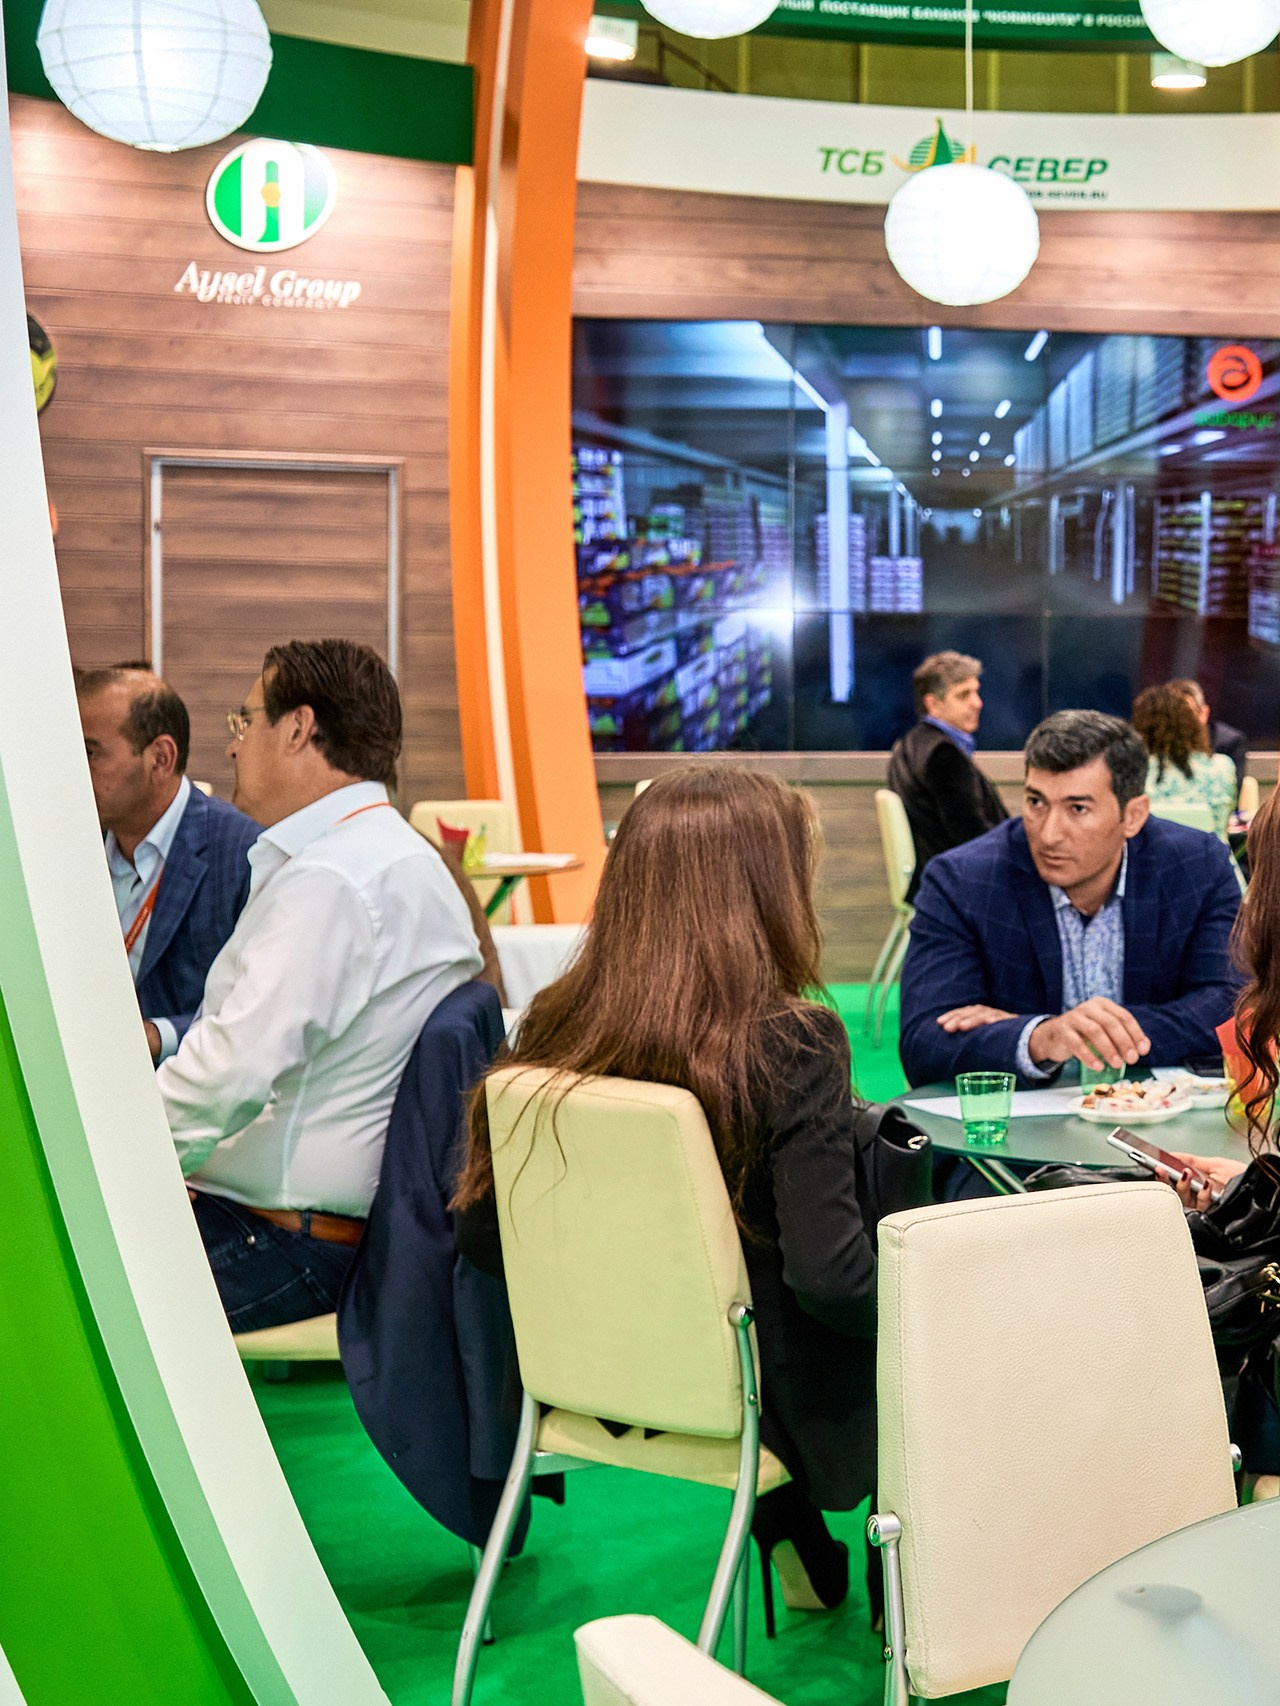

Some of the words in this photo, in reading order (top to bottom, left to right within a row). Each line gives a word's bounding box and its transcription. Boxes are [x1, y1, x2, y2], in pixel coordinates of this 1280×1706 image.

[818, 147, 885, 176] ТСБ
[174, 260, 268, 303] Aysel
[269, 269, 363, 309] Group
